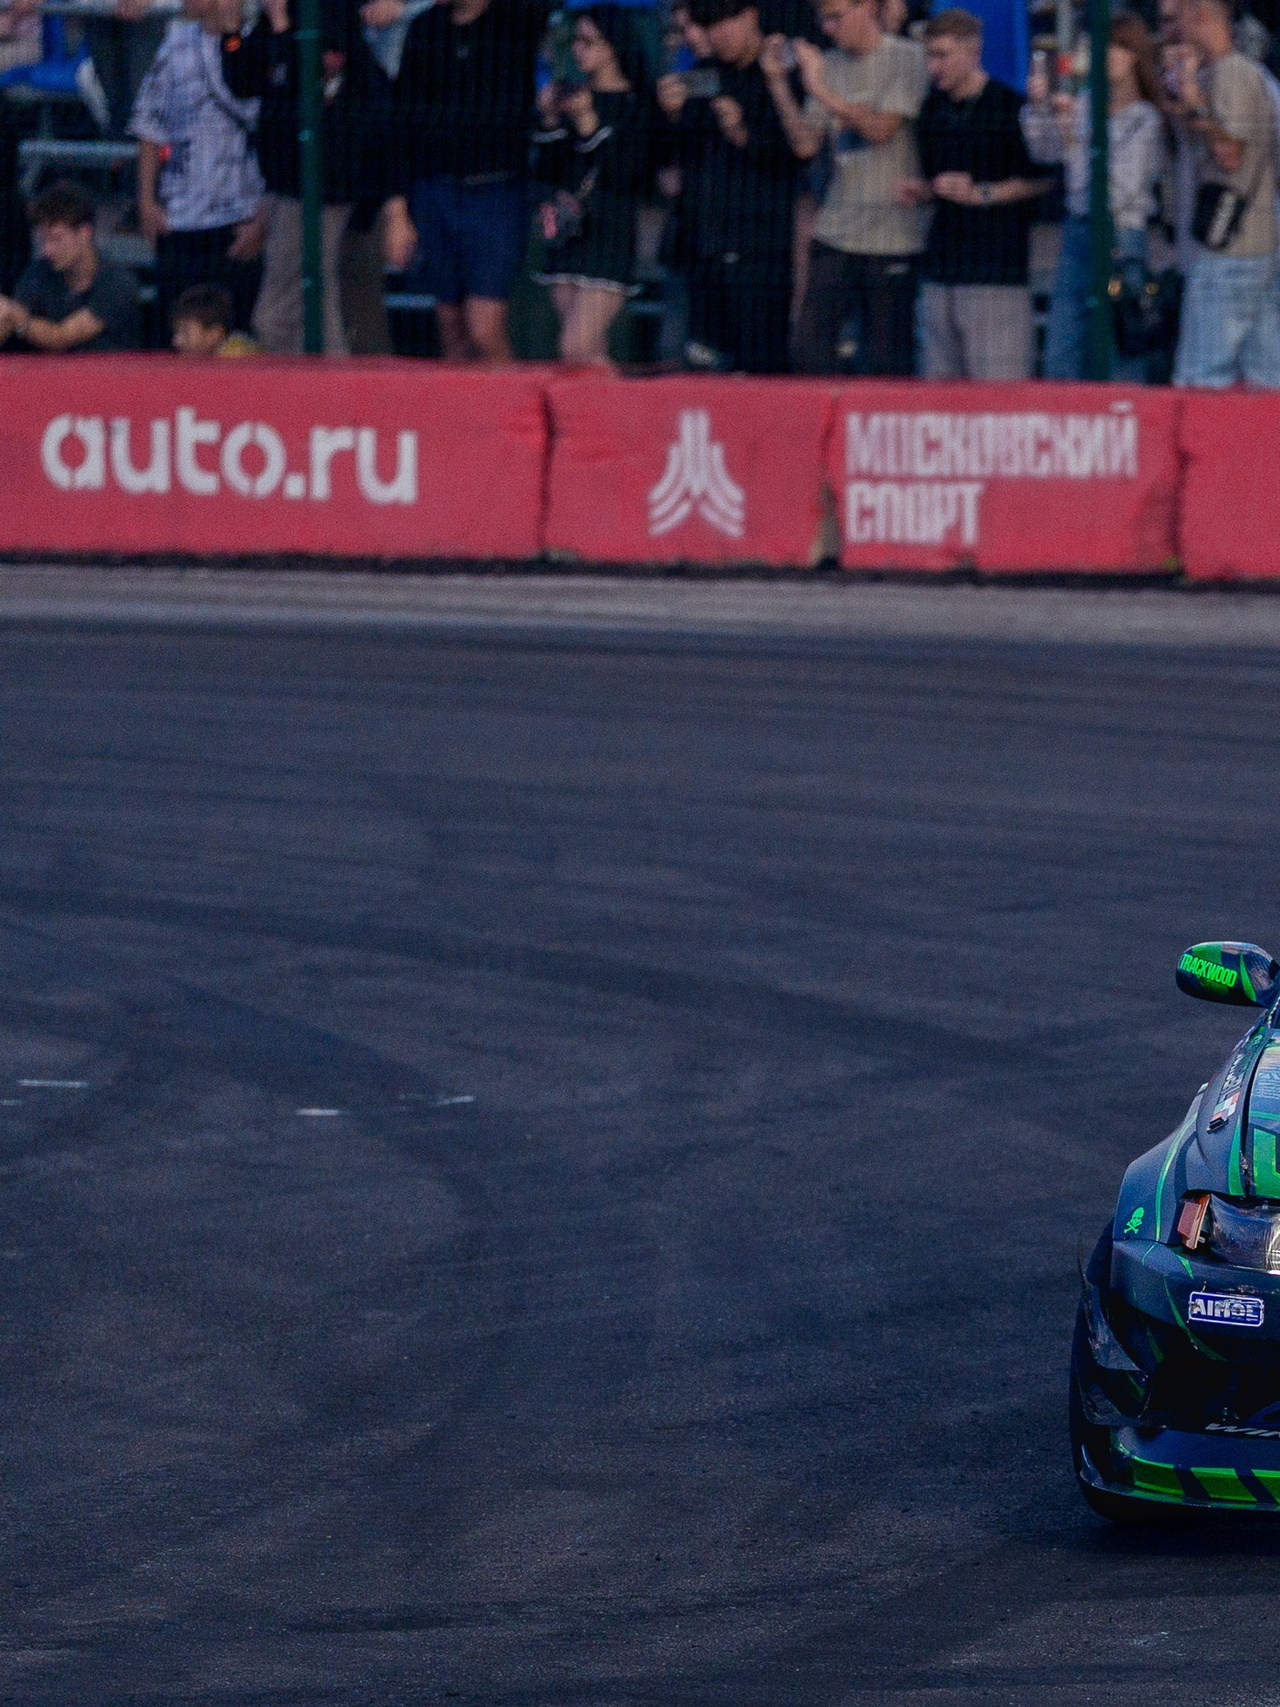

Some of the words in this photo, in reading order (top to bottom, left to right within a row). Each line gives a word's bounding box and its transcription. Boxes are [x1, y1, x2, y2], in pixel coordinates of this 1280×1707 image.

[41, 405, 418, 504] auto.ru
[846, 401, 1139, 478] МОСКОВСКИЙ
[846, 481, 983, 545] СПОРТ
[1180, 953, 1238, 988] TRACKWOOD
